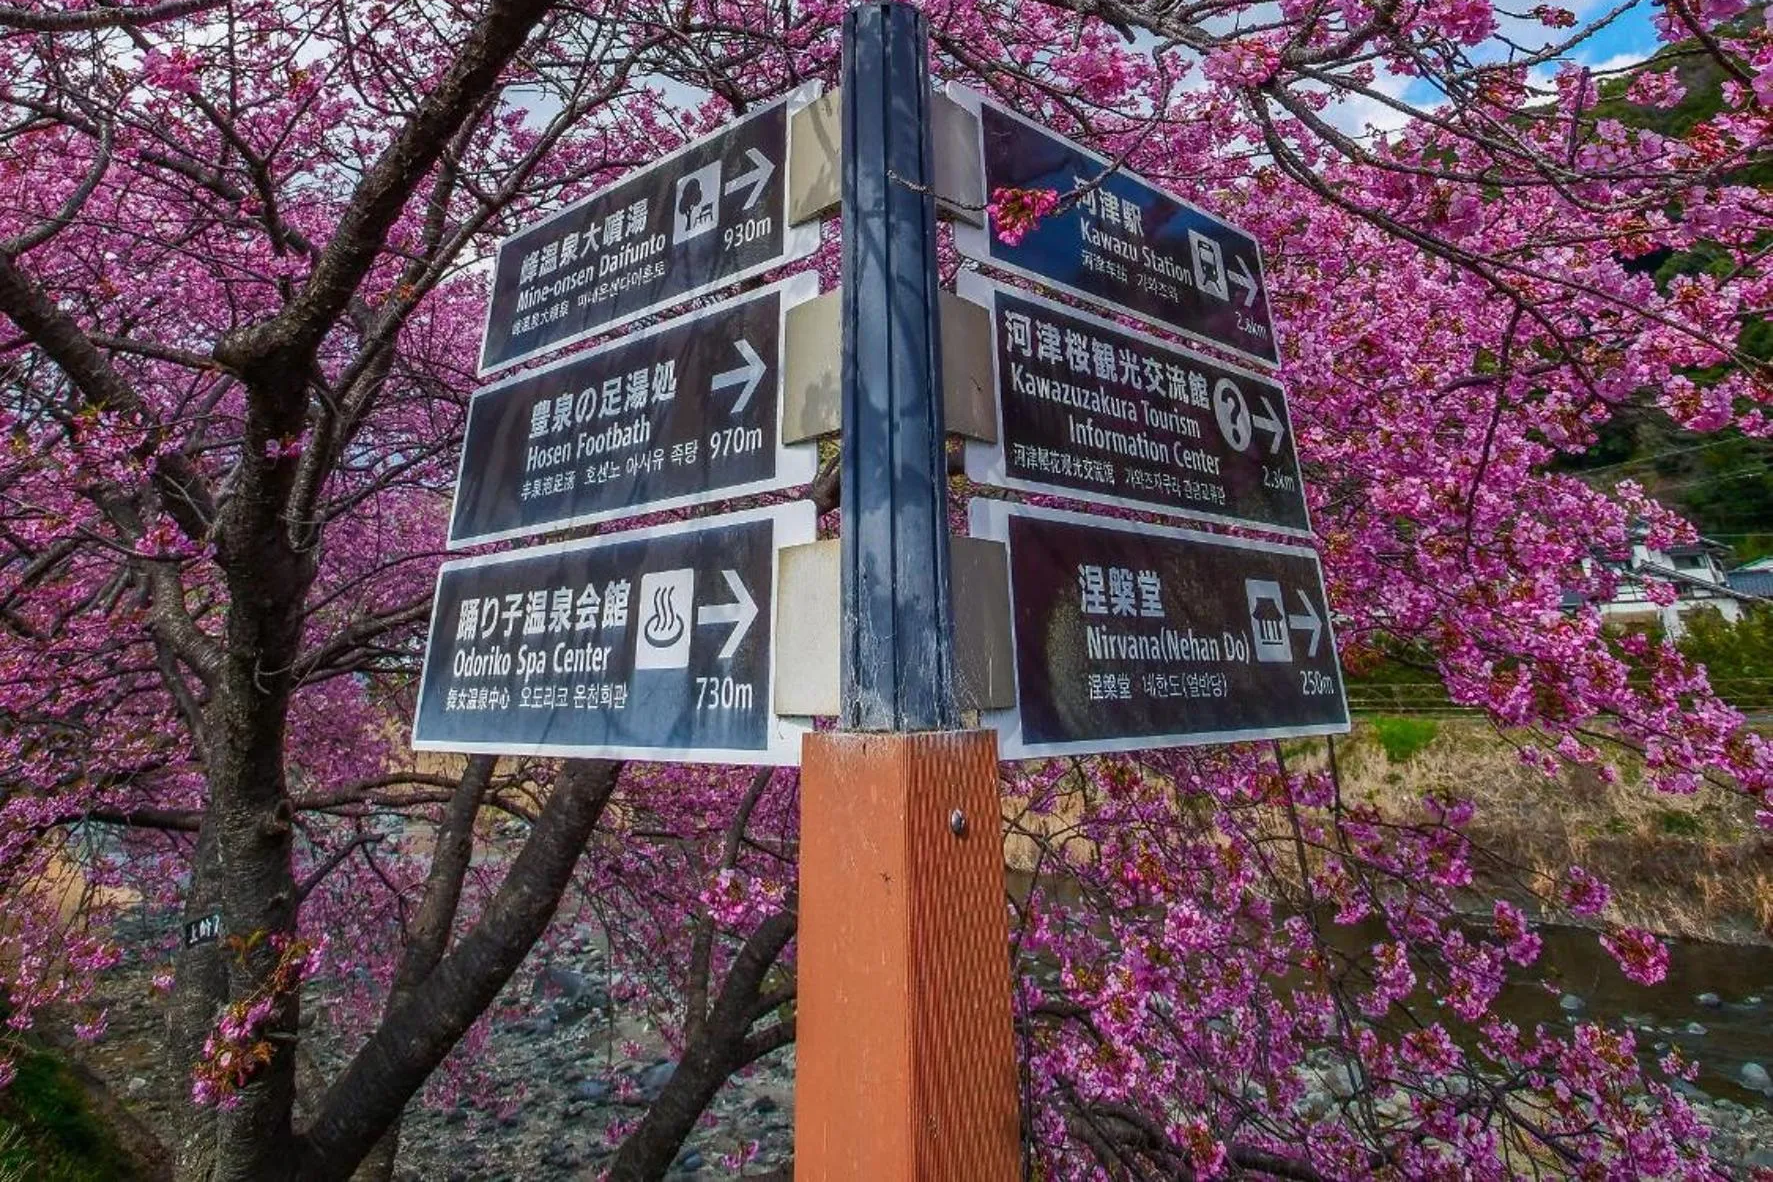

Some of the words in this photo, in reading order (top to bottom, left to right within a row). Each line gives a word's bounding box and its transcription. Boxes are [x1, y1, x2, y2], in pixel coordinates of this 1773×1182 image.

[723, 211, 772, 252] 930m
[1079, 218, 1138, 264] Kawazu
[1141, 244, 1192, 286] Station
[515, 261, 595, 313] Mine-onsen
[598, 227, 666, 278] Daifunto
[1011, 363, 1137, 423] Kawazuzakura
[1140, 399, 1200, 439] Tourism
[524, 436, 572, 473] Hosen
[575, 412, 651, 459] Footbath
[709, 421, 762, 461] 970m
[1068, 415, 1170, 464] Information
[1171, 440, 1223, 476] Center
[452, 646, 512, 677] Odoriko
[515, 643, 547, 681] Spa
[551, 638, 612, 673] Center
[1085, 625, 1221, 661] Nirvana(Nehan
[1222, 630, 1252, 663] Do)
[694, 675, 753, 708] 730m
[1298, 671, 1334, 695] 250m
